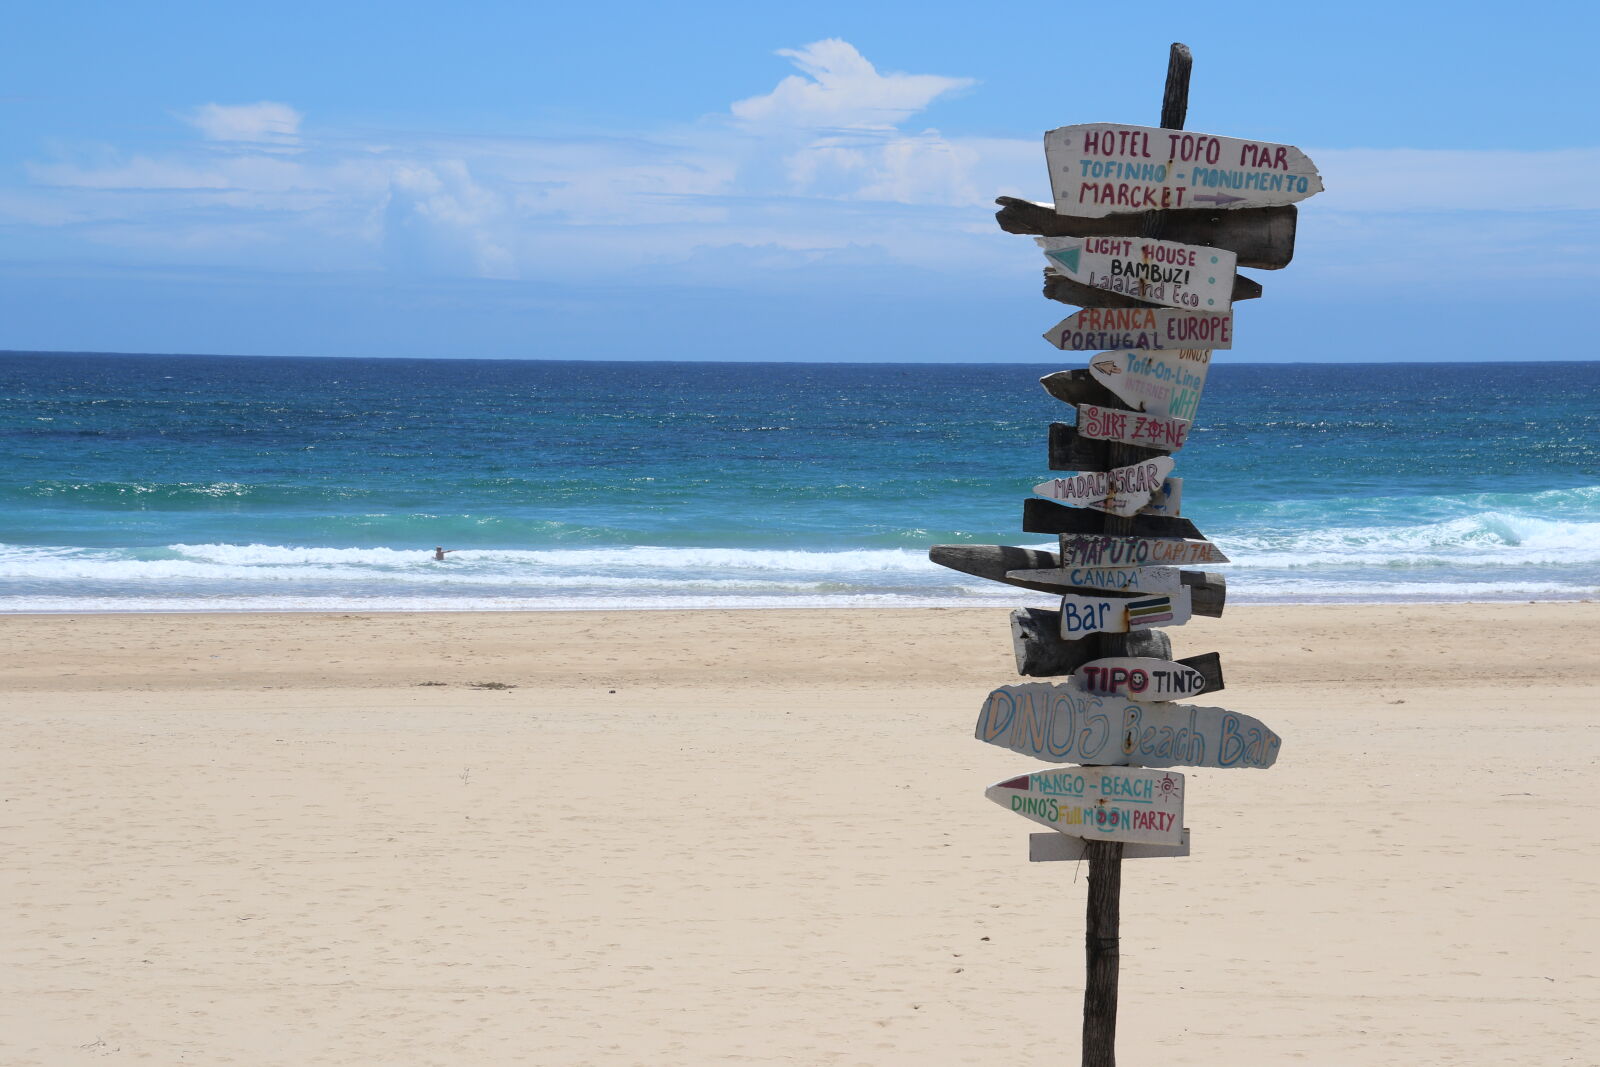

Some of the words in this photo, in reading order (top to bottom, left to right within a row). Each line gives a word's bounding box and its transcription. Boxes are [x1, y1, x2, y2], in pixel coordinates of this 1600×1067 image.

[1084, 130, 1151, 158] HOTEL
[1168, 134, 1221, 164] TOFO
[1240, 144, 1289, 171] MAR
[1079, 159, 1167, 183] TOFINHO
[1191, 166, 1308, 193] MONUMENTO
[1079, 182, 1187, 208] MARCKET
[1085, 238, 1132, 257] LIGHT
[1144, 245, 1197, 267] HOUSE
[1089, 272, 1165, 300] Lalaland
[1172, 285, 1199, 307] Eco
[1061, 329, 1164, 350] PORTUGAL
[1168, 317, 1230, 342] EUROPE
[1125, 377, 1170, 401] INTERNET
[1131, 417, 1185, 447] ZONE
[1054, 463, 1161, 499] MADAGASCAR
[1071, 536, 1149, 566] MAPUTO
[1152, 541, 1214, 561] CAPITAL
[1071, 569, 1139, 589] CANADA
[1065, 602, 1110, 632] Bar
[1083, 666, 1149, 694] TIPO
[1153, 670, 1205, 694] TINTO
[1121, 705, 1205, 766] Beach
[1218, 714, 1281, 766] Bar
[1029, 773, 1085, 797] MANGO
[1101, 776, 1153, 799] BEACH
[1011, 795, 1059, 823] DINO'S
[1083, 806, 1131, 831] MOON
[1133, 810, 1176, 833] PARTY
